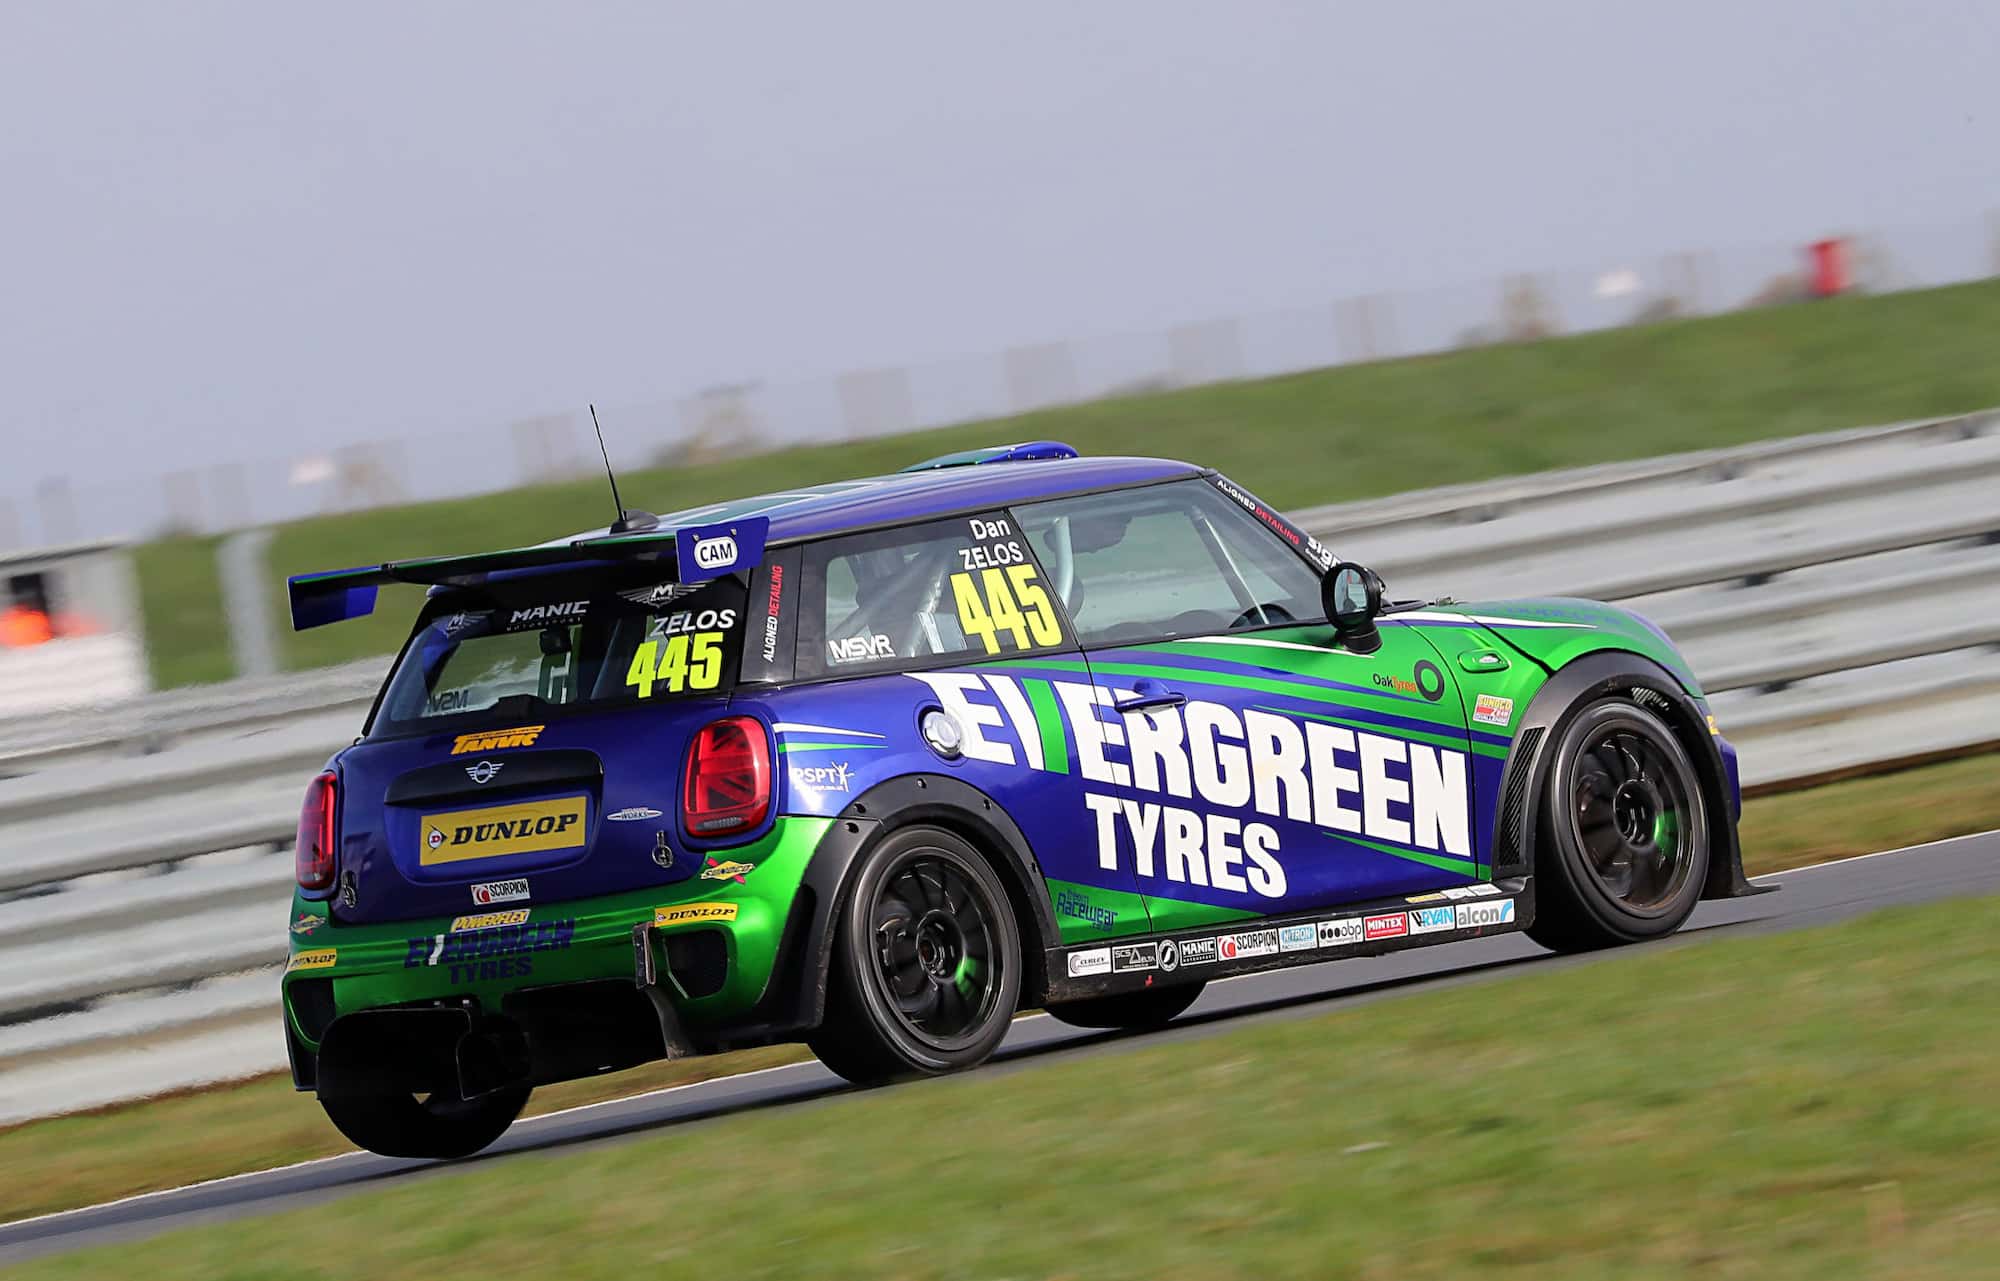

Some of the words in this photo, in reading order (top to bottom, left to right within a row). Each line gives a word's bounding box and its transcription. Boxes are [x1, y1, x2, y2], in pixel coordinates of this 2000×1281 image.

[1217, 480, 1256, 511] ALIGNED
[1255, 507, 1300, 545] DETAILING
[969, 519, 1011, 540] Dan
[700, 543, 733, 562] CAM
[959, 542, 1024, 570] ZELOS
[768, 564, 784, 617] DETAILING
[510, 600, 591, 624] MANIC
[650, 609, 736, 637] ZELOS
[949, 564, 1063, 656] 445
[763, 616, 778, 663] ALIGNED
[828, 634, 894, 659] MSVR
[626, 632, 724, 698] 445
[903, 672, 1472, 857] EVERGREEN
[451, 813, 579, 846] DUNLOP
[1085, 792, 1288, 898] TYRES
[489, 881, 528, 897] SCORPION
[451, 911, 528, 932] POWERFLEX
[669, 908, 735, 920] DUNLOP
[1367, 917, 1403, 931] MINTEX
[1458, 906, 1500, 926] alcon
[404, 918, 576, 968] EVERGREEN
[1182, 940, 1215, 955] MANIC
[1236, 928, 1277, 951] SCORPION
[448, 956, 533, 985] TYRES
